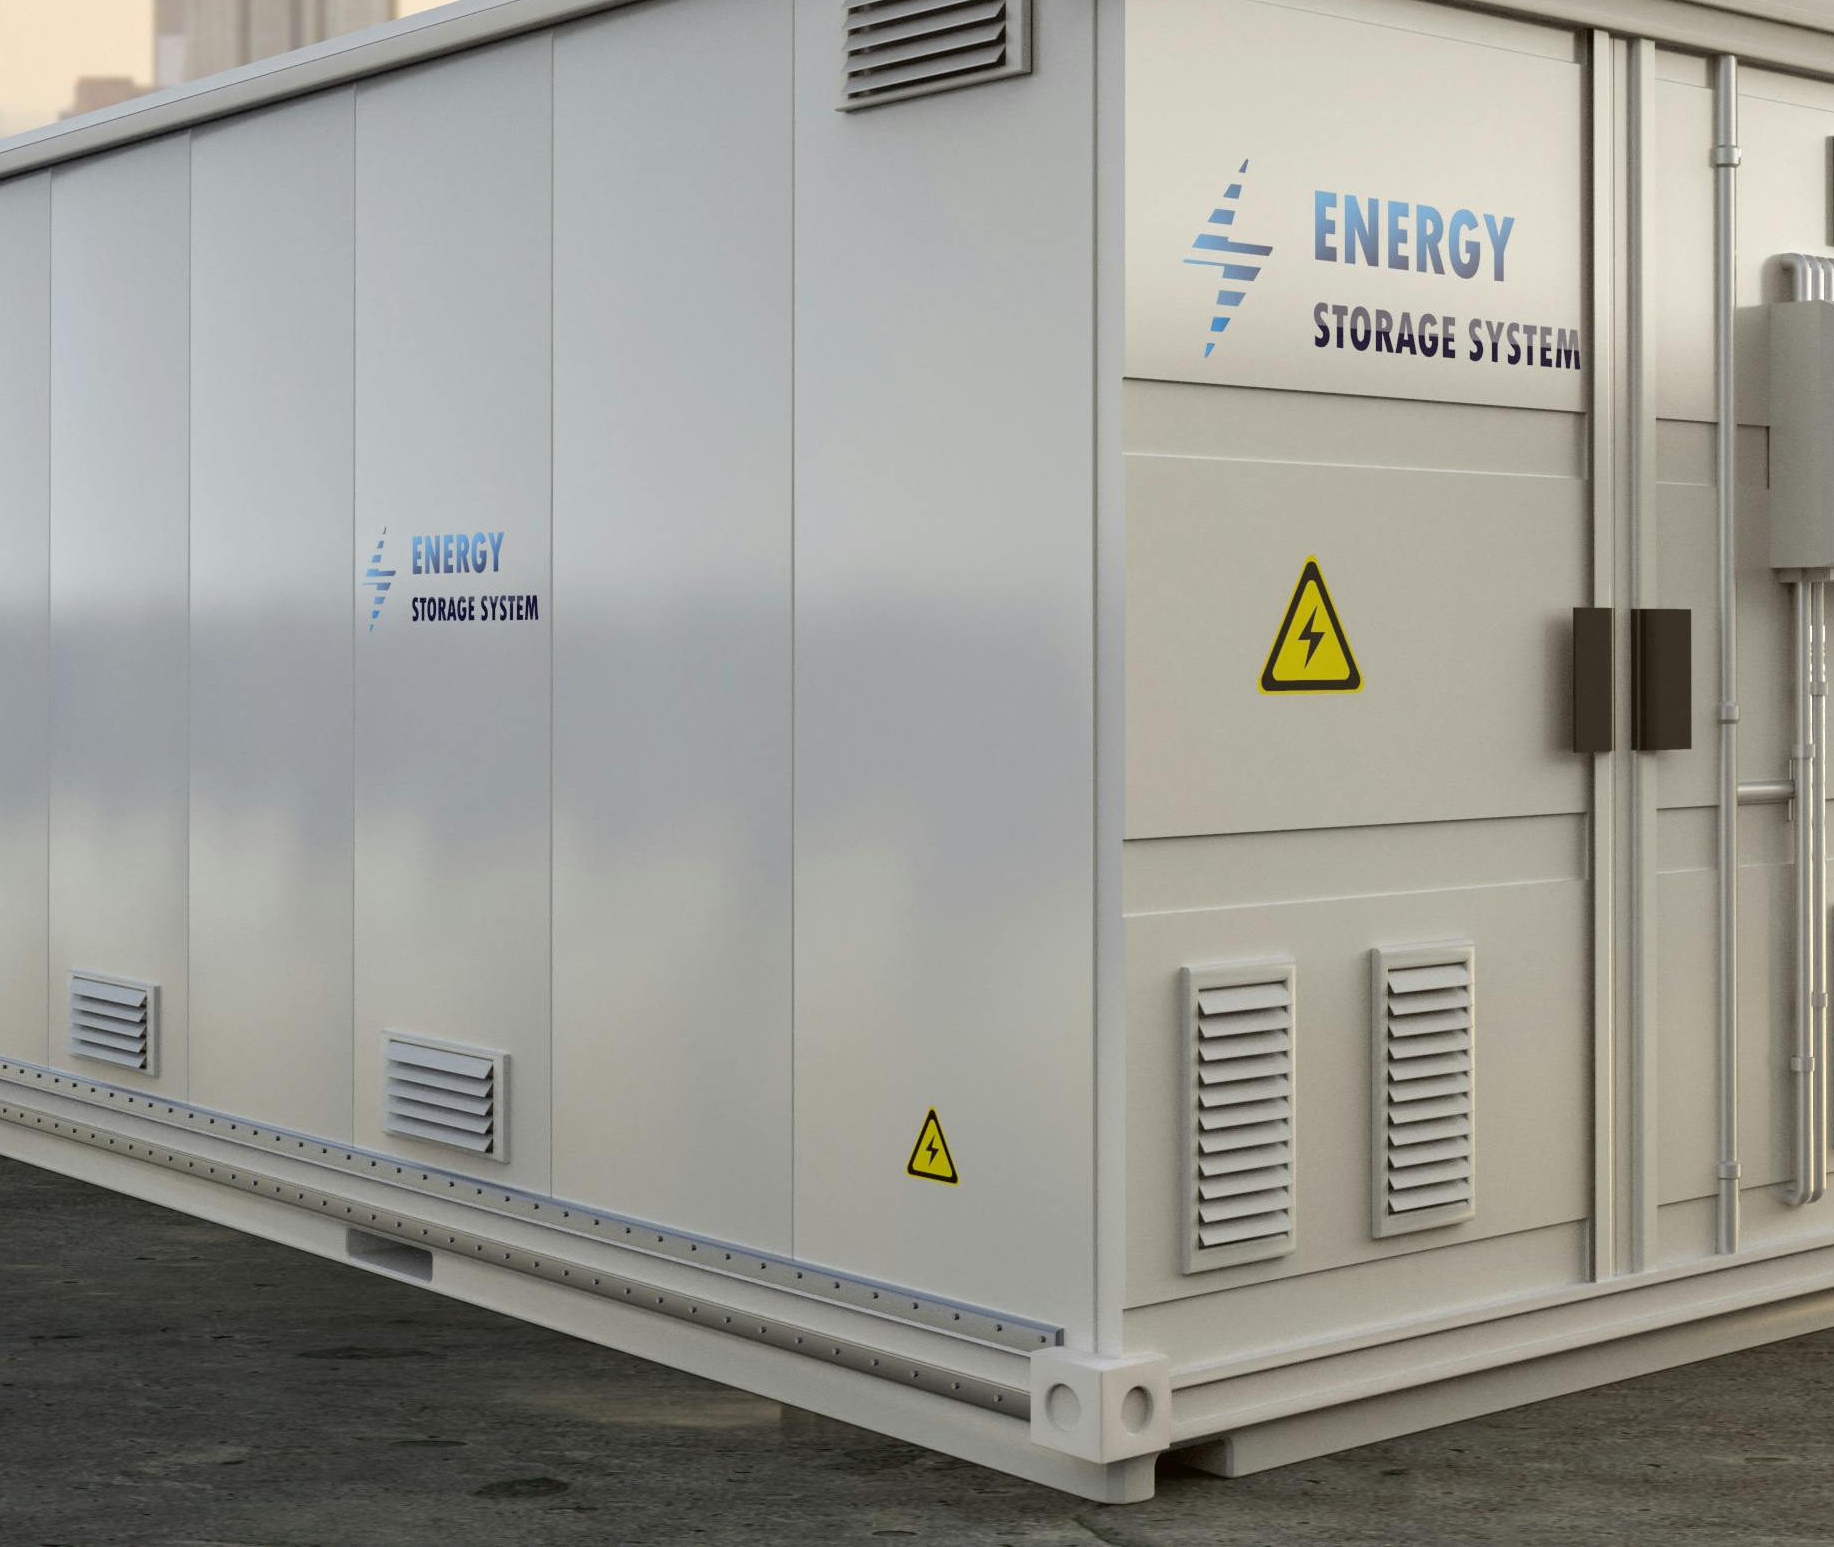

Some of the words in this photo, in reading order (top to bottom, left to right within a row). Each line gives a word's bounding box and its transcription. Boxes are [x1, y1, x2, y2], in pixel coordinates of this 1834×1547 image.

[1314, 190, 1515, 282] ENERGY
[1313, 302, 1456, 359] STORAGE
[1469, 318, 1581, 370] SYSTEM
[412, 532, 505, 575] ENERGY
[412, 596, 475, 622] STORAGE
[481, 595, 539, 621] SYSTEM
